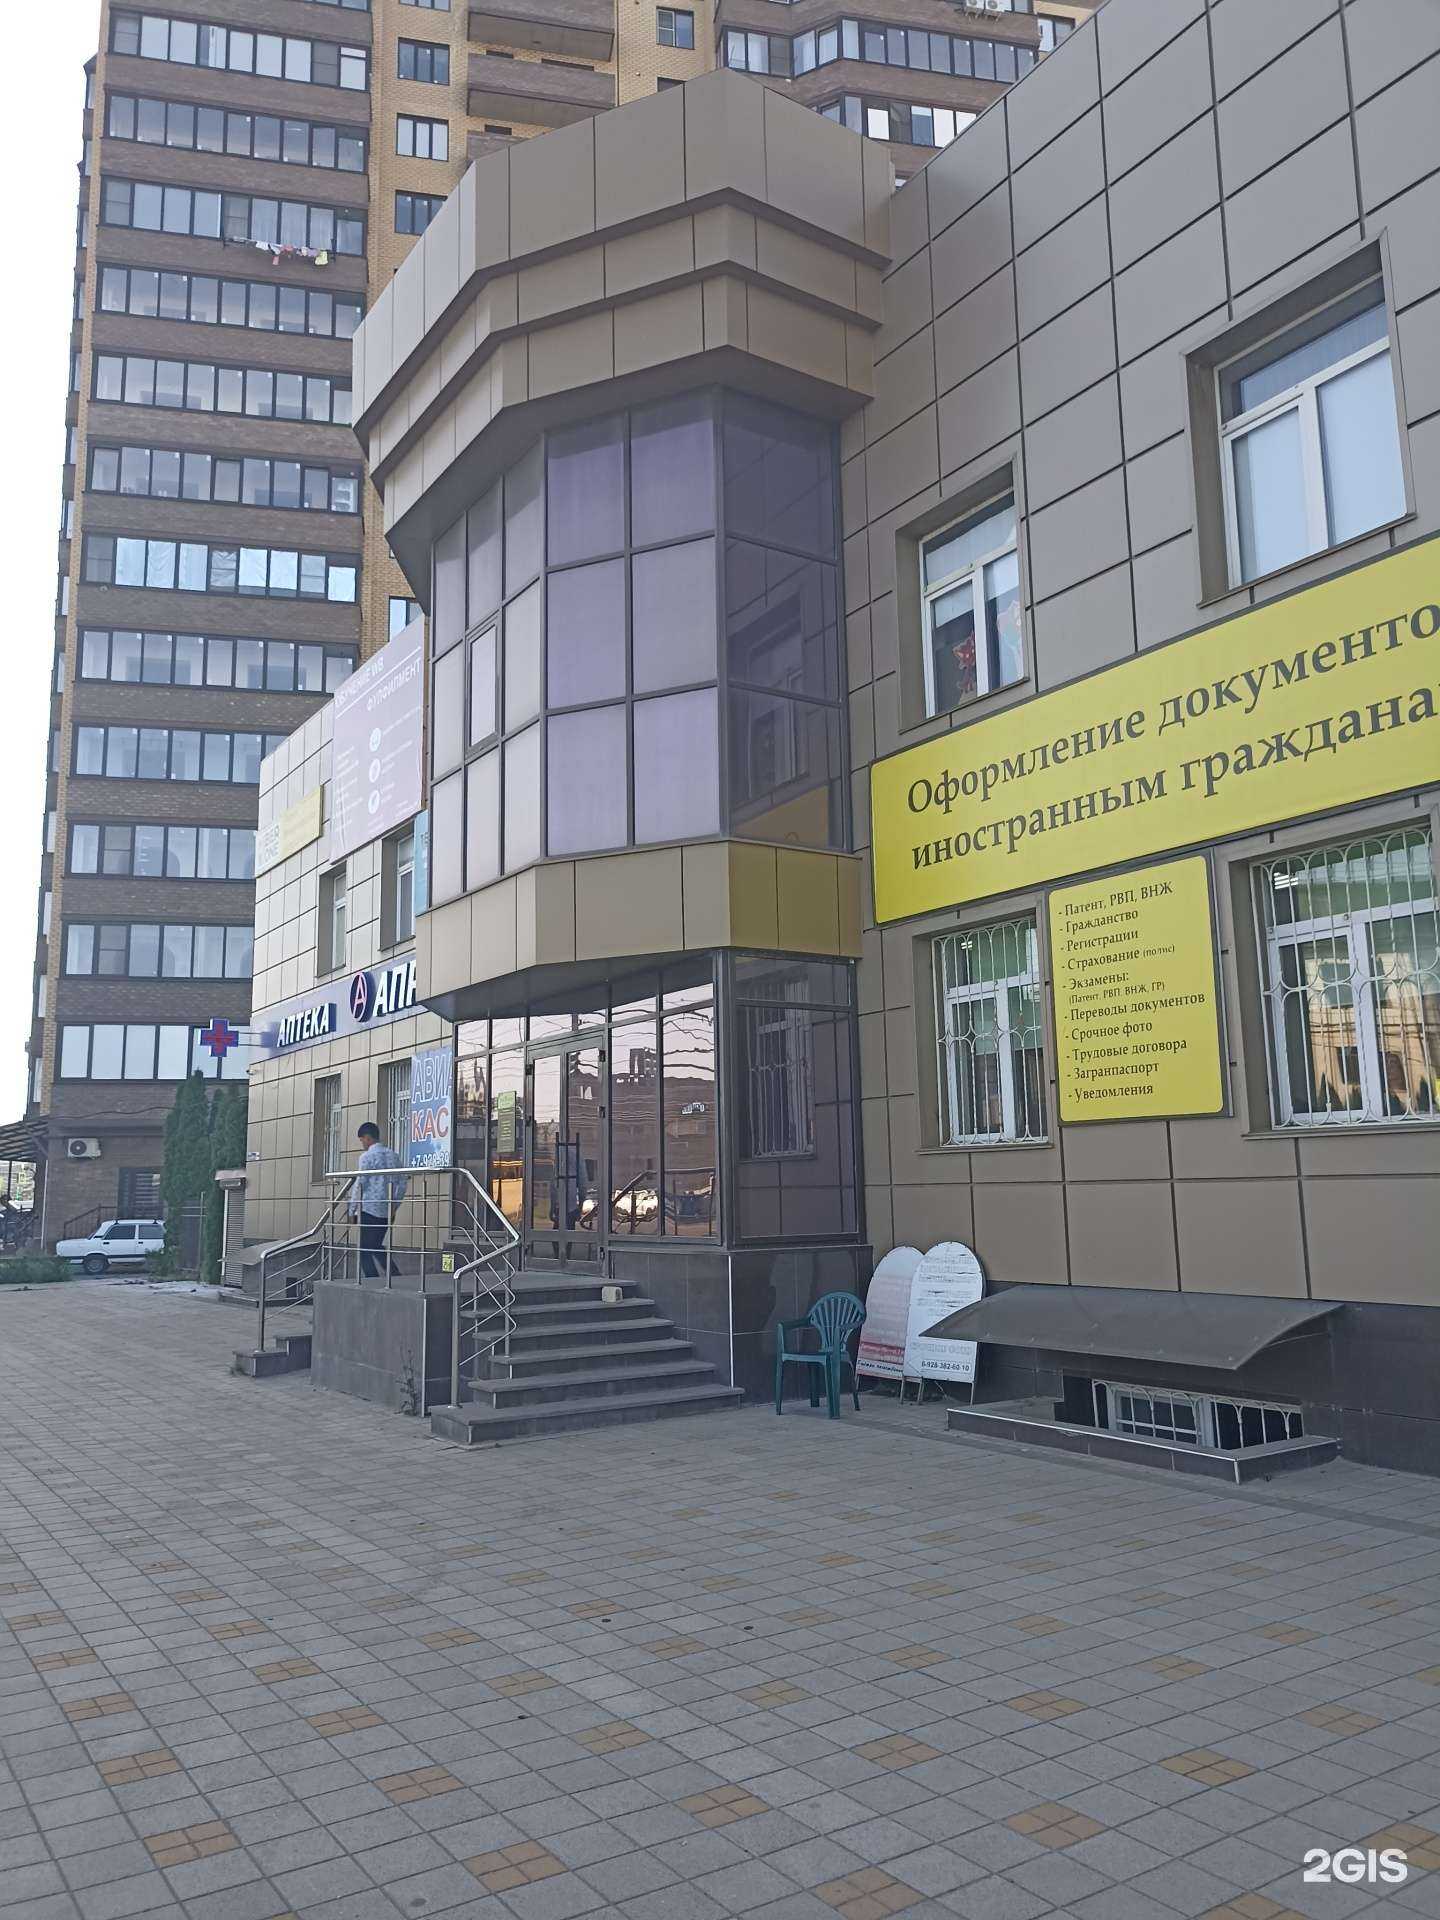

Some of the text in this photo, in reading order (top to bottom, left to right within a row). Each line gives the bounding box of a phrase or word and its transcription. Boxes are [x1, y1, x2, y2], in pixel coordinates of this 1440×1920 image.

[907, 603, 1440, 815] Оформление документо
[911, 684, 1440, 871] иностранным граждана
[1064, 881, 1173, 917] Патент, РВП, ВНЖ
[1066, 909, 1139, 934] Гражданство
[1066, 930, 1139, 952] Регистрации
[1067, 949, 1140, 972] Страхование
[1069, 971, 1129, 990] Экзамены:
[1070, 993, 1205, 1023] Переводы документов
[277, 1003, 329, 1048] АПТЕКА
[1071, 1020, 1153, 1043] Срочное фото
[1072, 1038, 1187, 1062] Трудовые договора
[1074, 1062, 1160, 1081] Загранпаспорт
[1074, 1083, 1154, 1103] Уведомления
[411, 1105, 449, 1142] КАС
